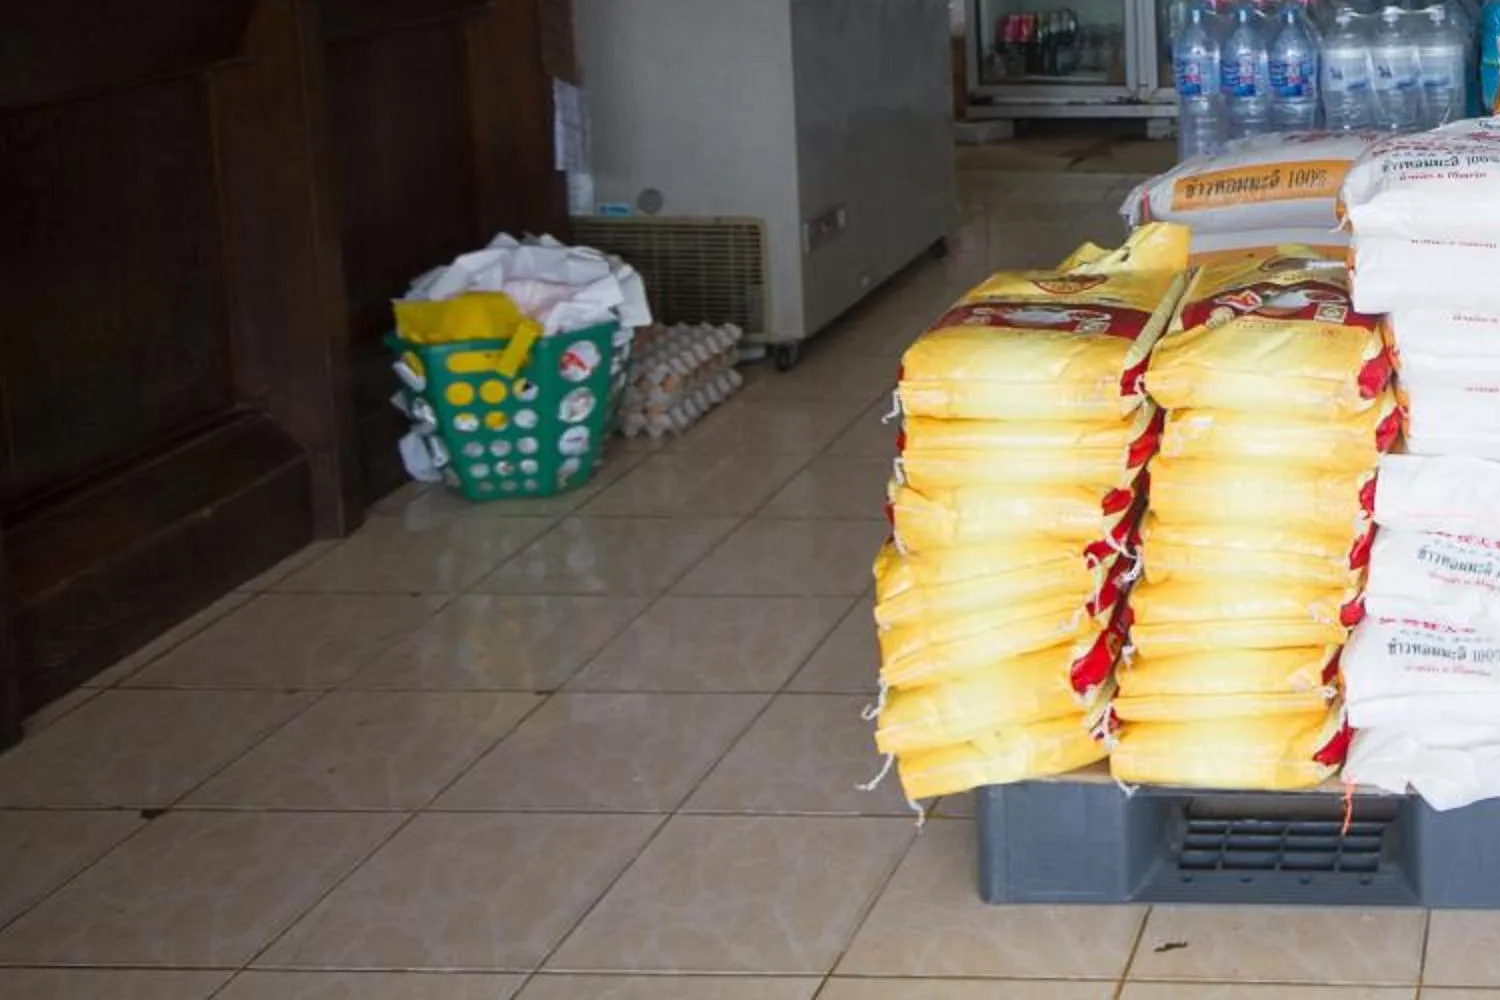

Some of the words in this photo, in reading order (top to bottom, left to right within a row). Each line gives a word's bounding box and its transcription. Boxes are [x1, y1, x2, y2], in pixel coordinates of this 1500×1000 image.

[1185, 169, 1281, 198] ข้าวหอมมะลิ
